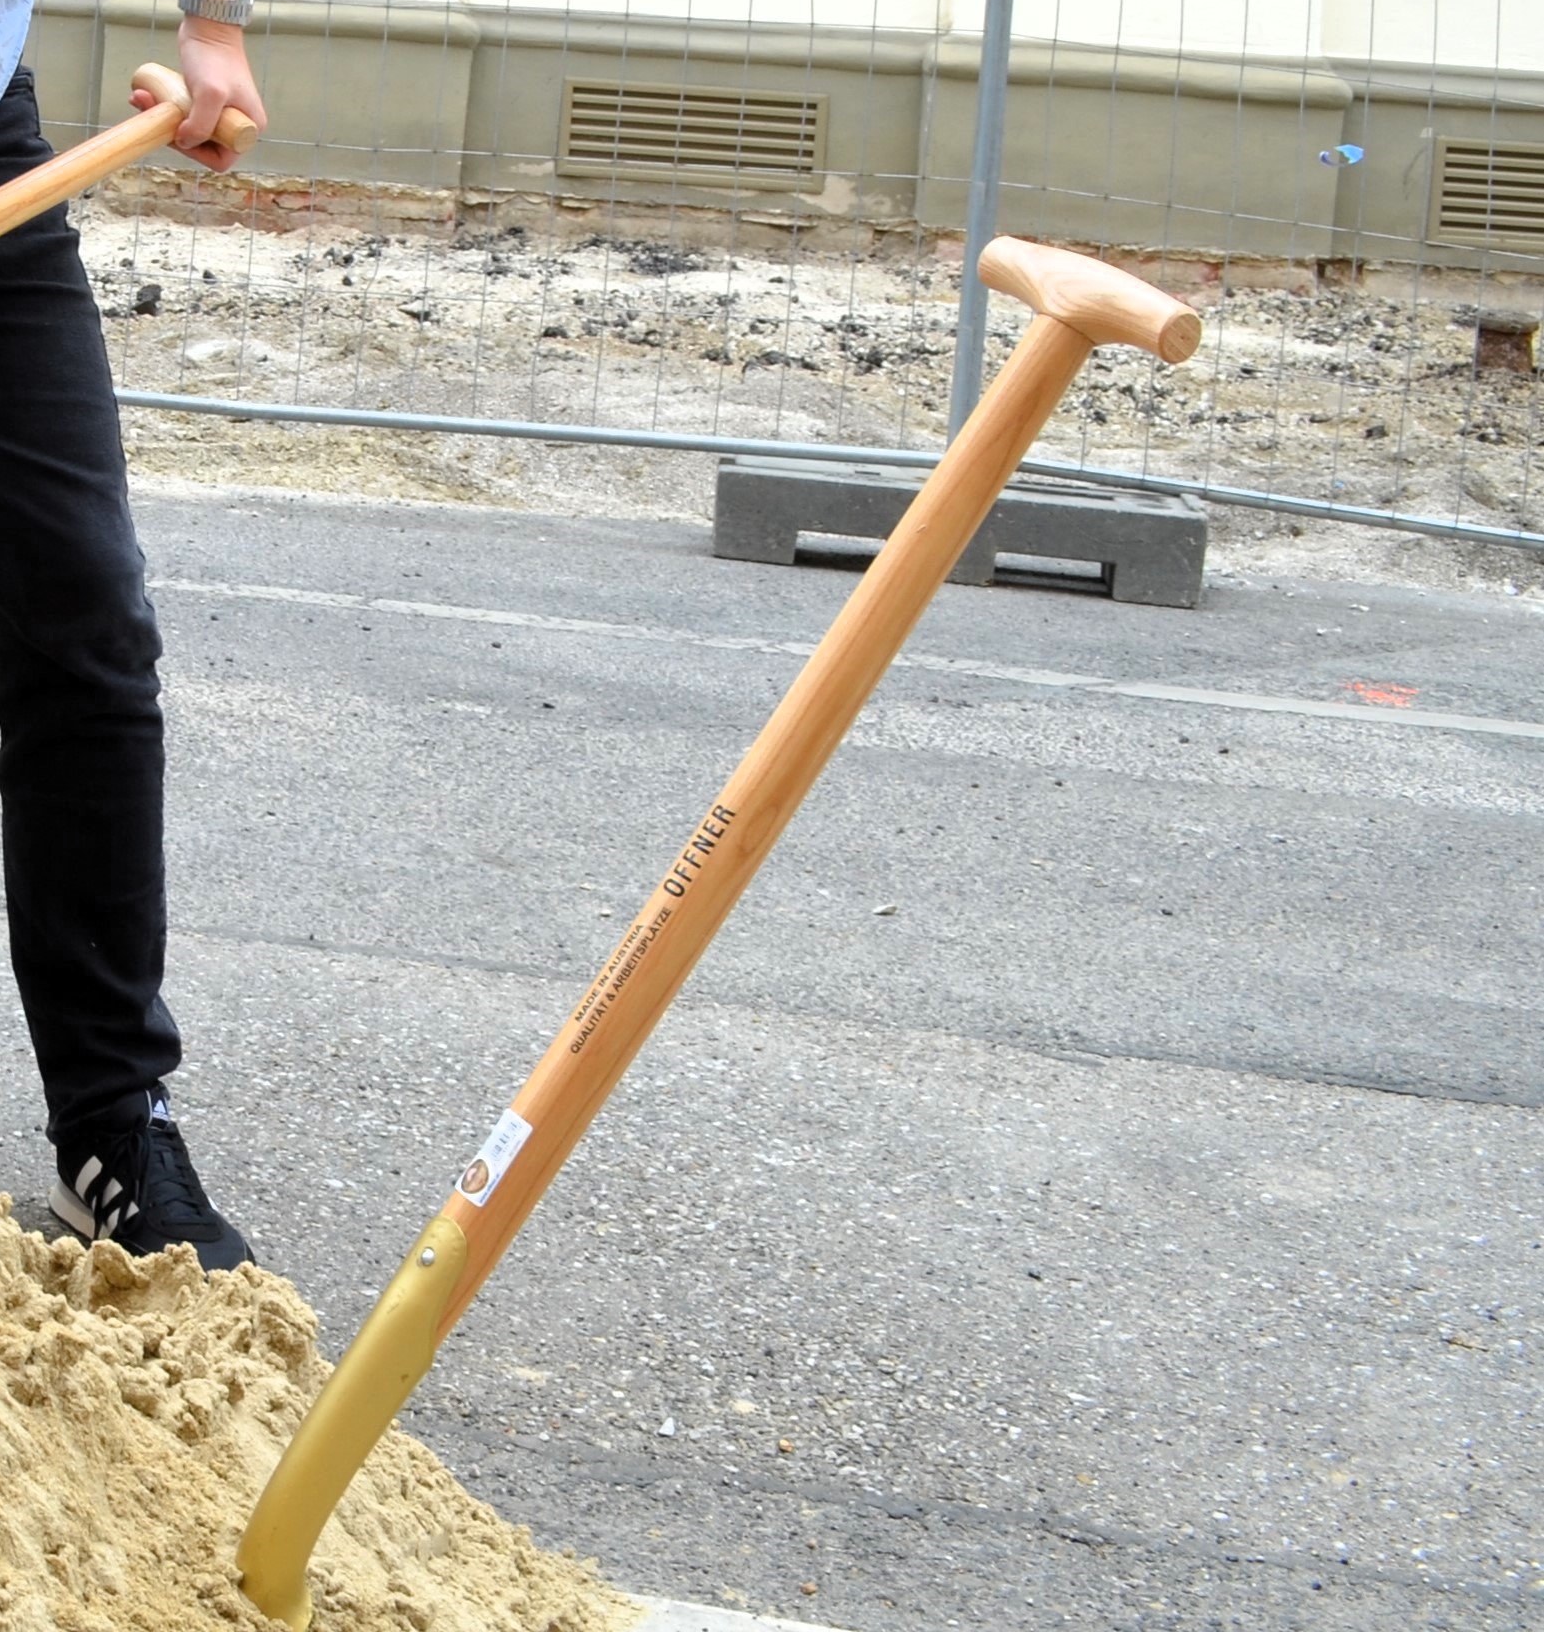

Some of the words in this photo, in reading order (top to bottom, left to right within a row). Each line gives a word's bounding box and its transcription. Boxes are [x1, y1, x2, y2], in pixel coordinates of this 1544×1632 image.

[663, 804, 736, 897] OFFNER
[575, 989, 600, 1023] MADE
[599, 975, 609, 989] IN
[608, 923, 643, 974] AUSTRIA
[607, 991, 616, 1002] &
